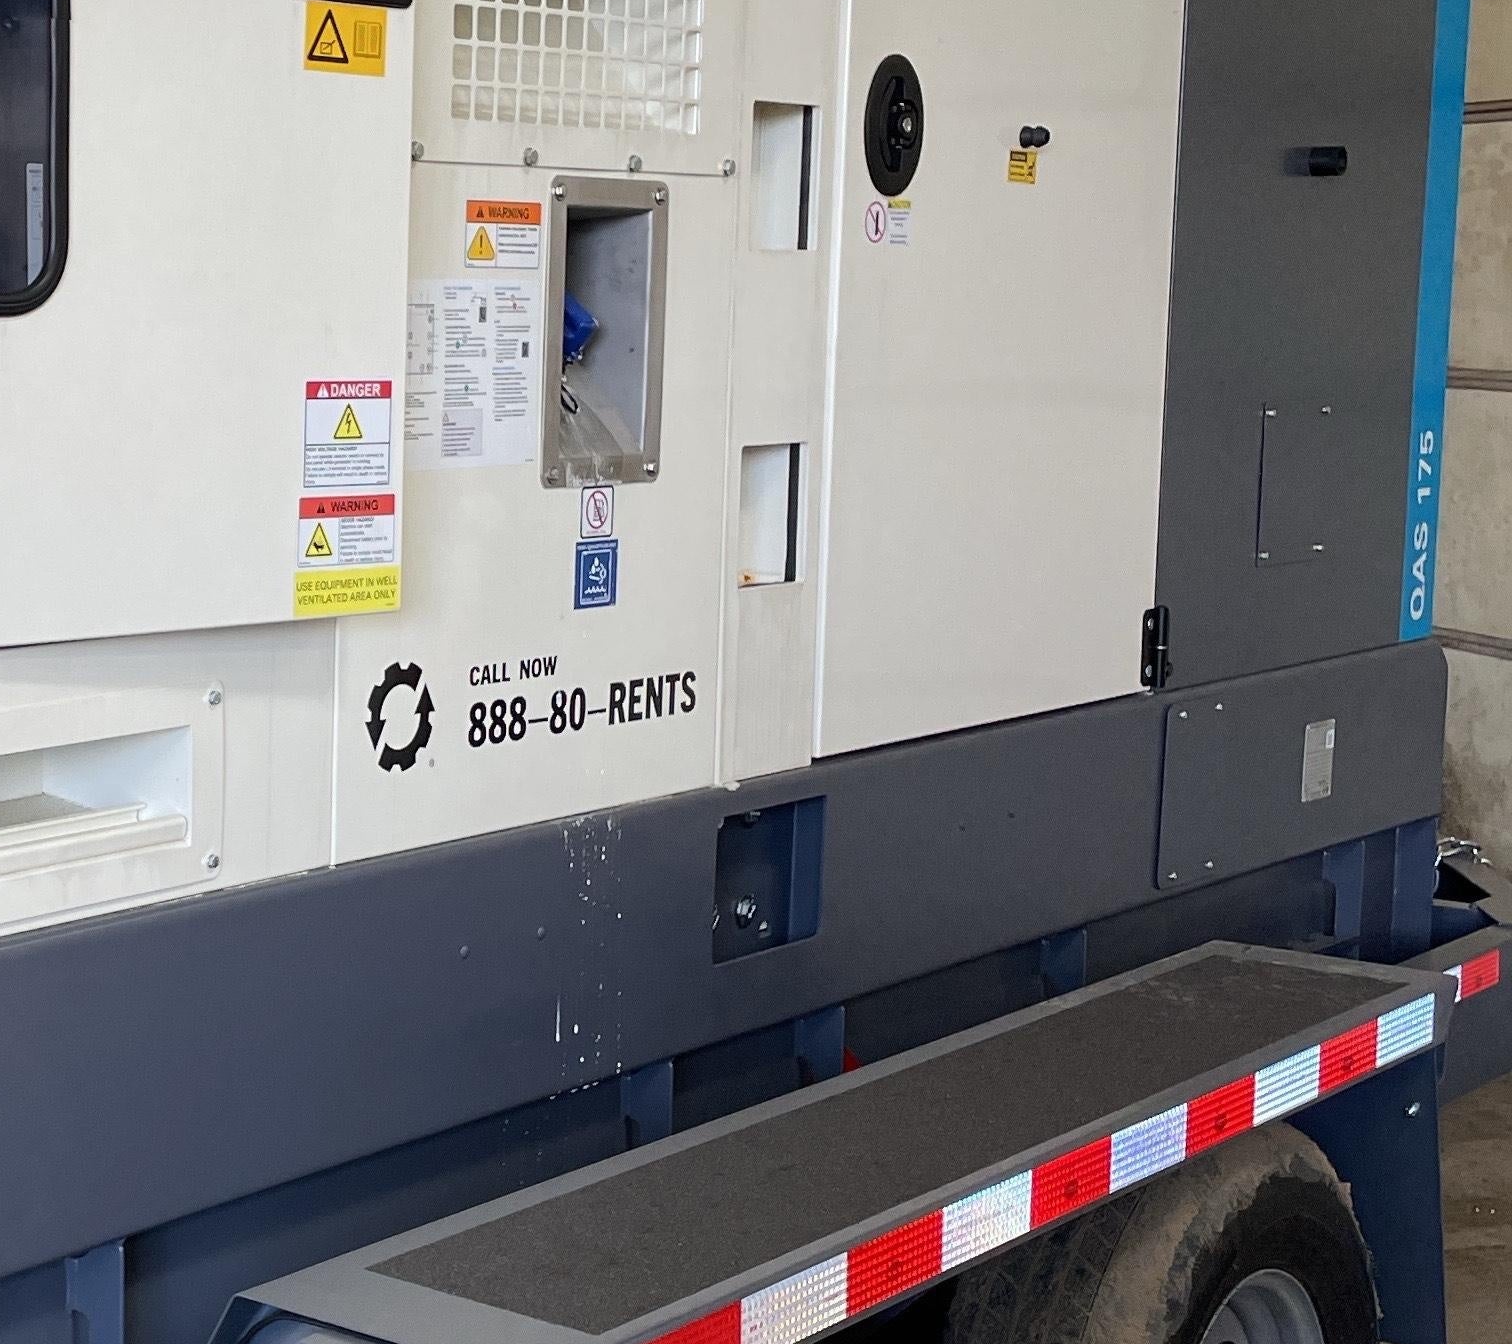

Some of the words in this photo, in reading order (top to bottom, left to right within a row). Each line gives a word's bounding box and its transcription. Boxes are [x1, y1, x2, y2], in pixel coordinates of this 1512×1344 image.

[488, 206, 530, 220] WARNING
[330, 382, 382, 398] DANGER
[1417, 429, 1435, 505] 175
[330, 499, 380, 513] WARNING
[1409, 521, 1429, 622] QAS
[296, 580, 313, 592] USE
[314, 577, 365, 591] EQUIPMENT
[365, 576, 375, 587] IN
[376, 574, 398, 586] WELL
[297, 592, 349, 606] VENTILATED
[349, 590, 372, 602] AREA
[373, 588, 396, 600] ONLY
[468, 663, 511, 687] CALL
[519, 655, 558, 680] NOW
[467, 670, 697, 748] 888-80-RENTS
